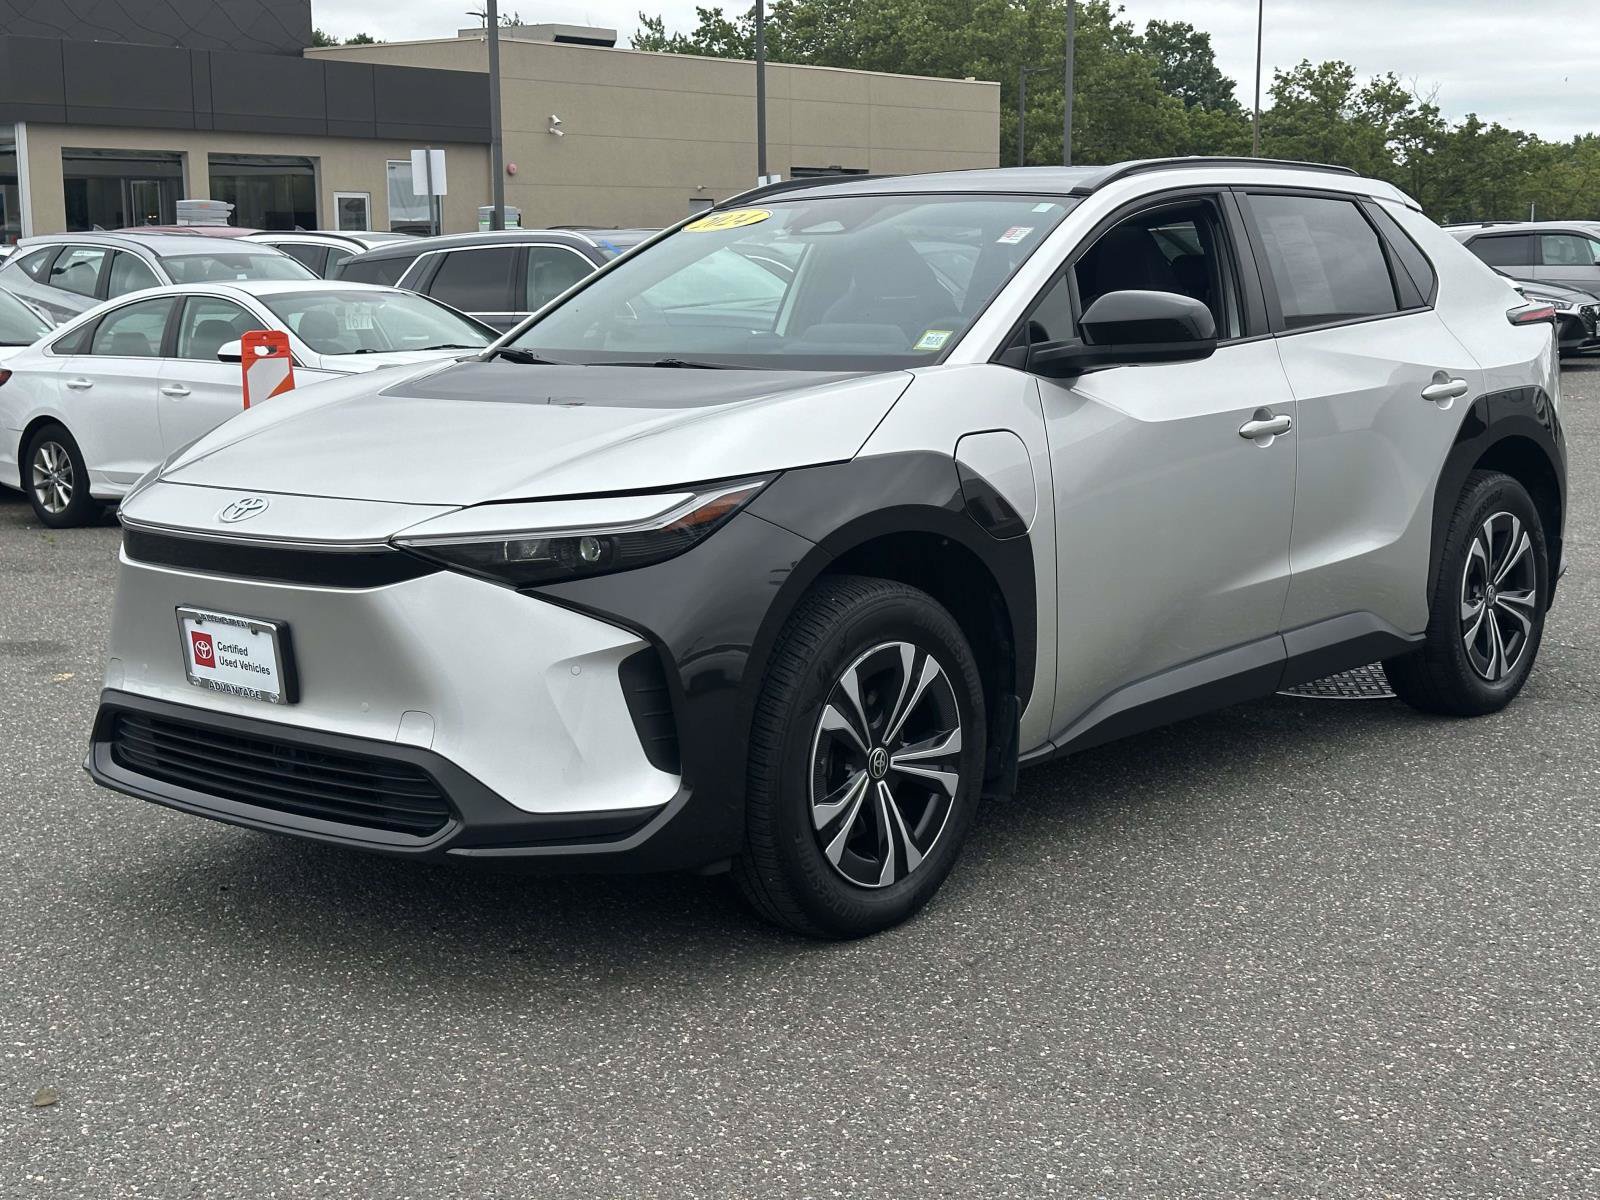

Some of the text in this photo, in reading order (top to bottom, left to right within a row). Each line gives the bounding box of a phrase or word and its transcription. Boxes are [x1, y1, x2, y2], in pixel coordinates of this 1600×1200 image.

[217, 641, 249, 657] Certified
[218, 656, 271, 676] Used Vehicles
[208, 681, 261, 699] ADVANTAGE
